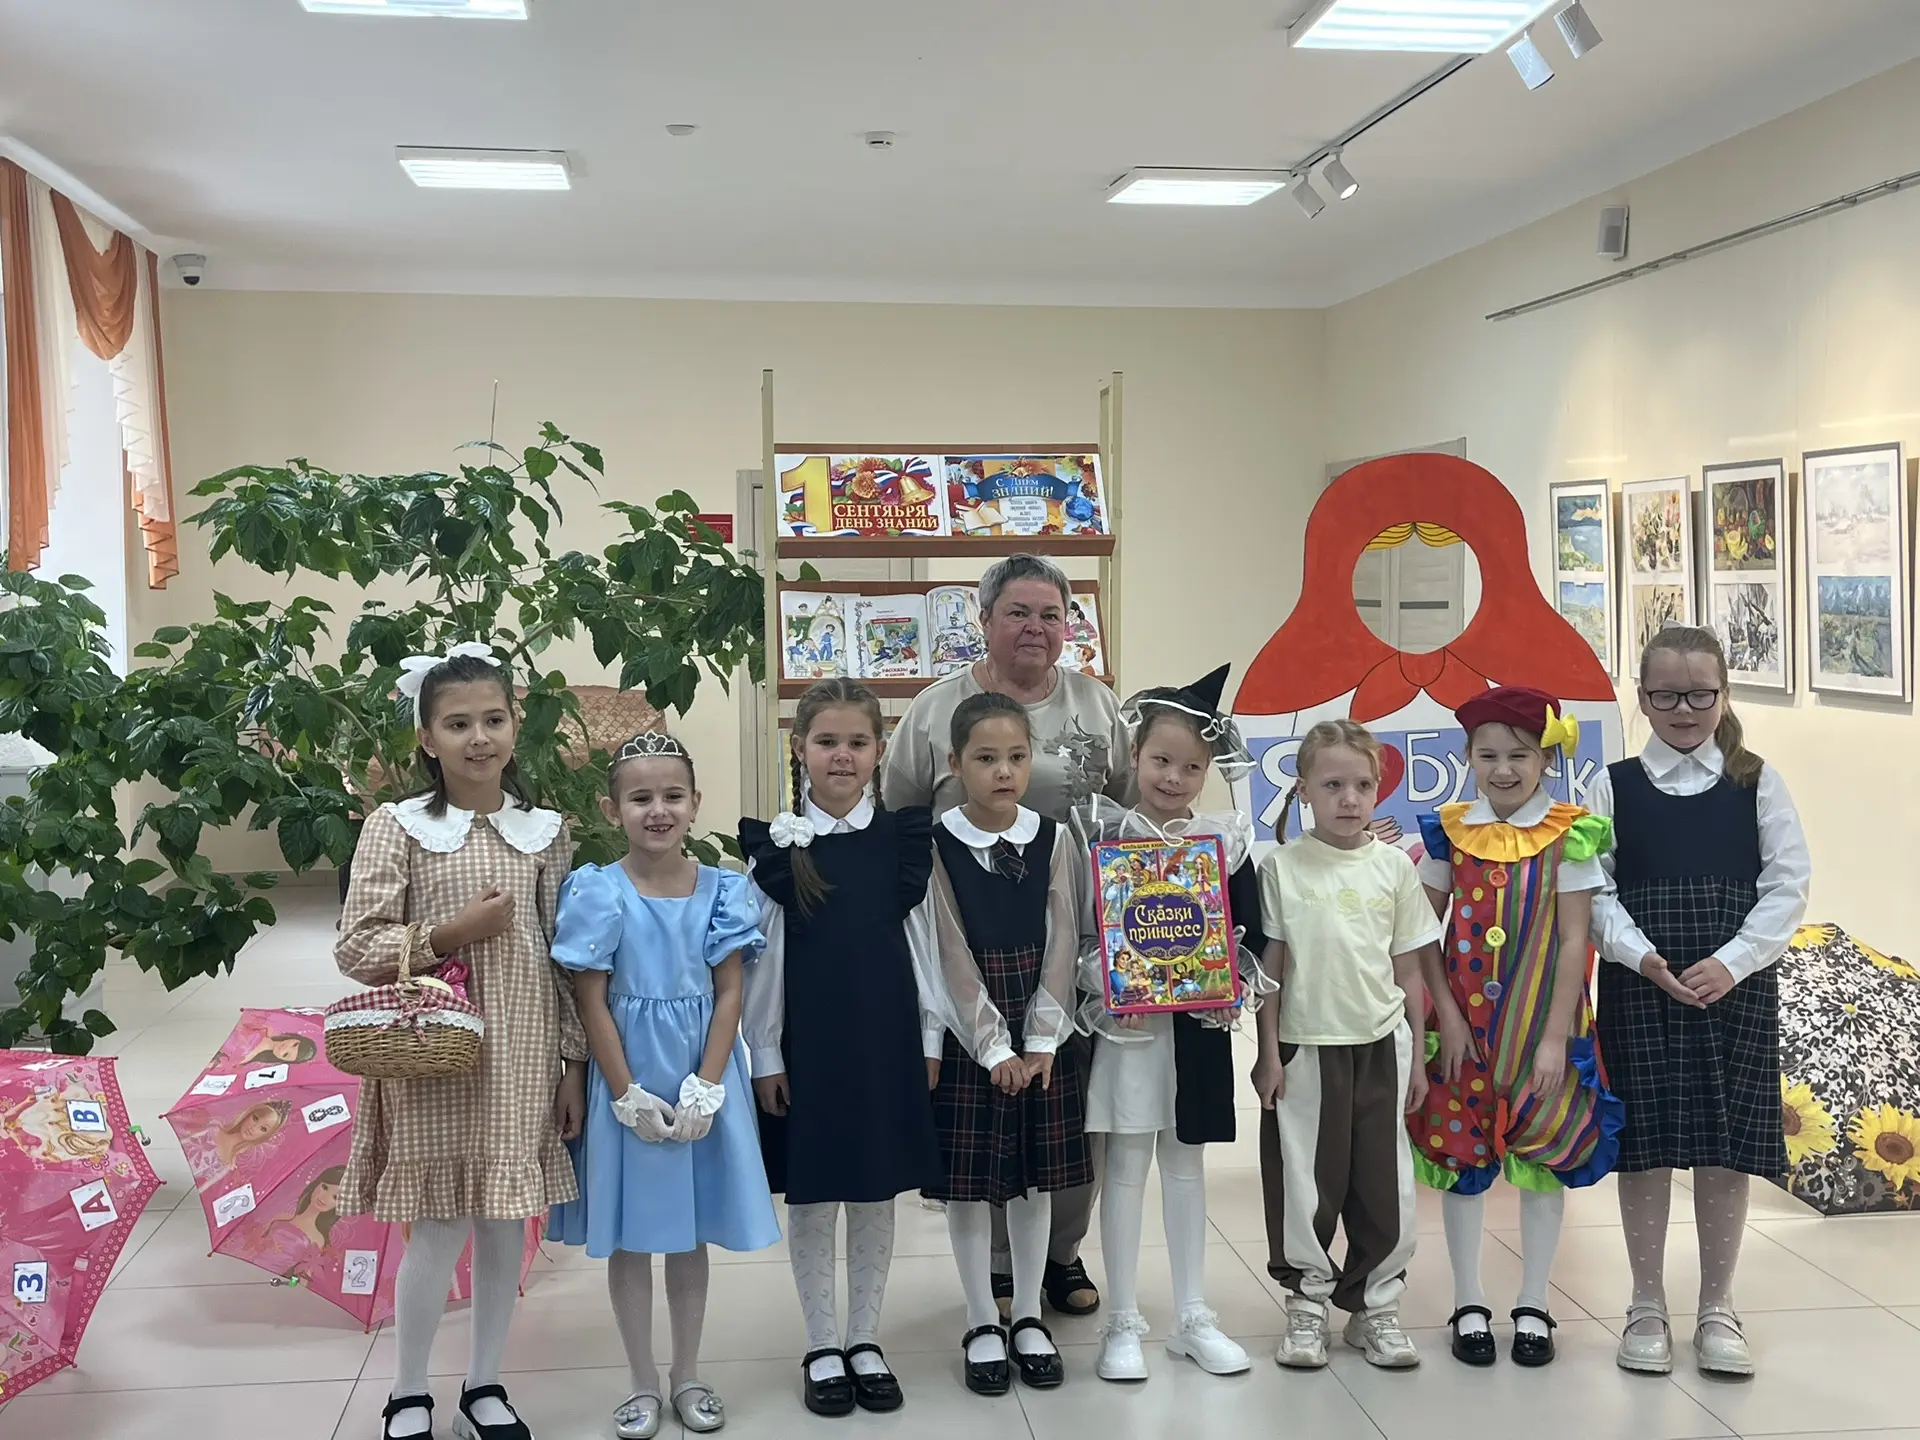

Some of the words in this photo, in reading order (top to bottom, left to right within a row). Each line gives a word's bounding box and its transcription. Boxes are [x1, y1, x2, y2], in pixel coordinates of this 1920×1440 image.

[781, 456, 831, 533] 1
[835, 517, 873, 530] ДЕНЬ
[876, 515, 938, 529] ЗНАНИЙ
[1134, 904, 1193, 926] Сказки
[1129, 924, 1202, 944] принцесс
[351, 1256, 368, 1288] 2
